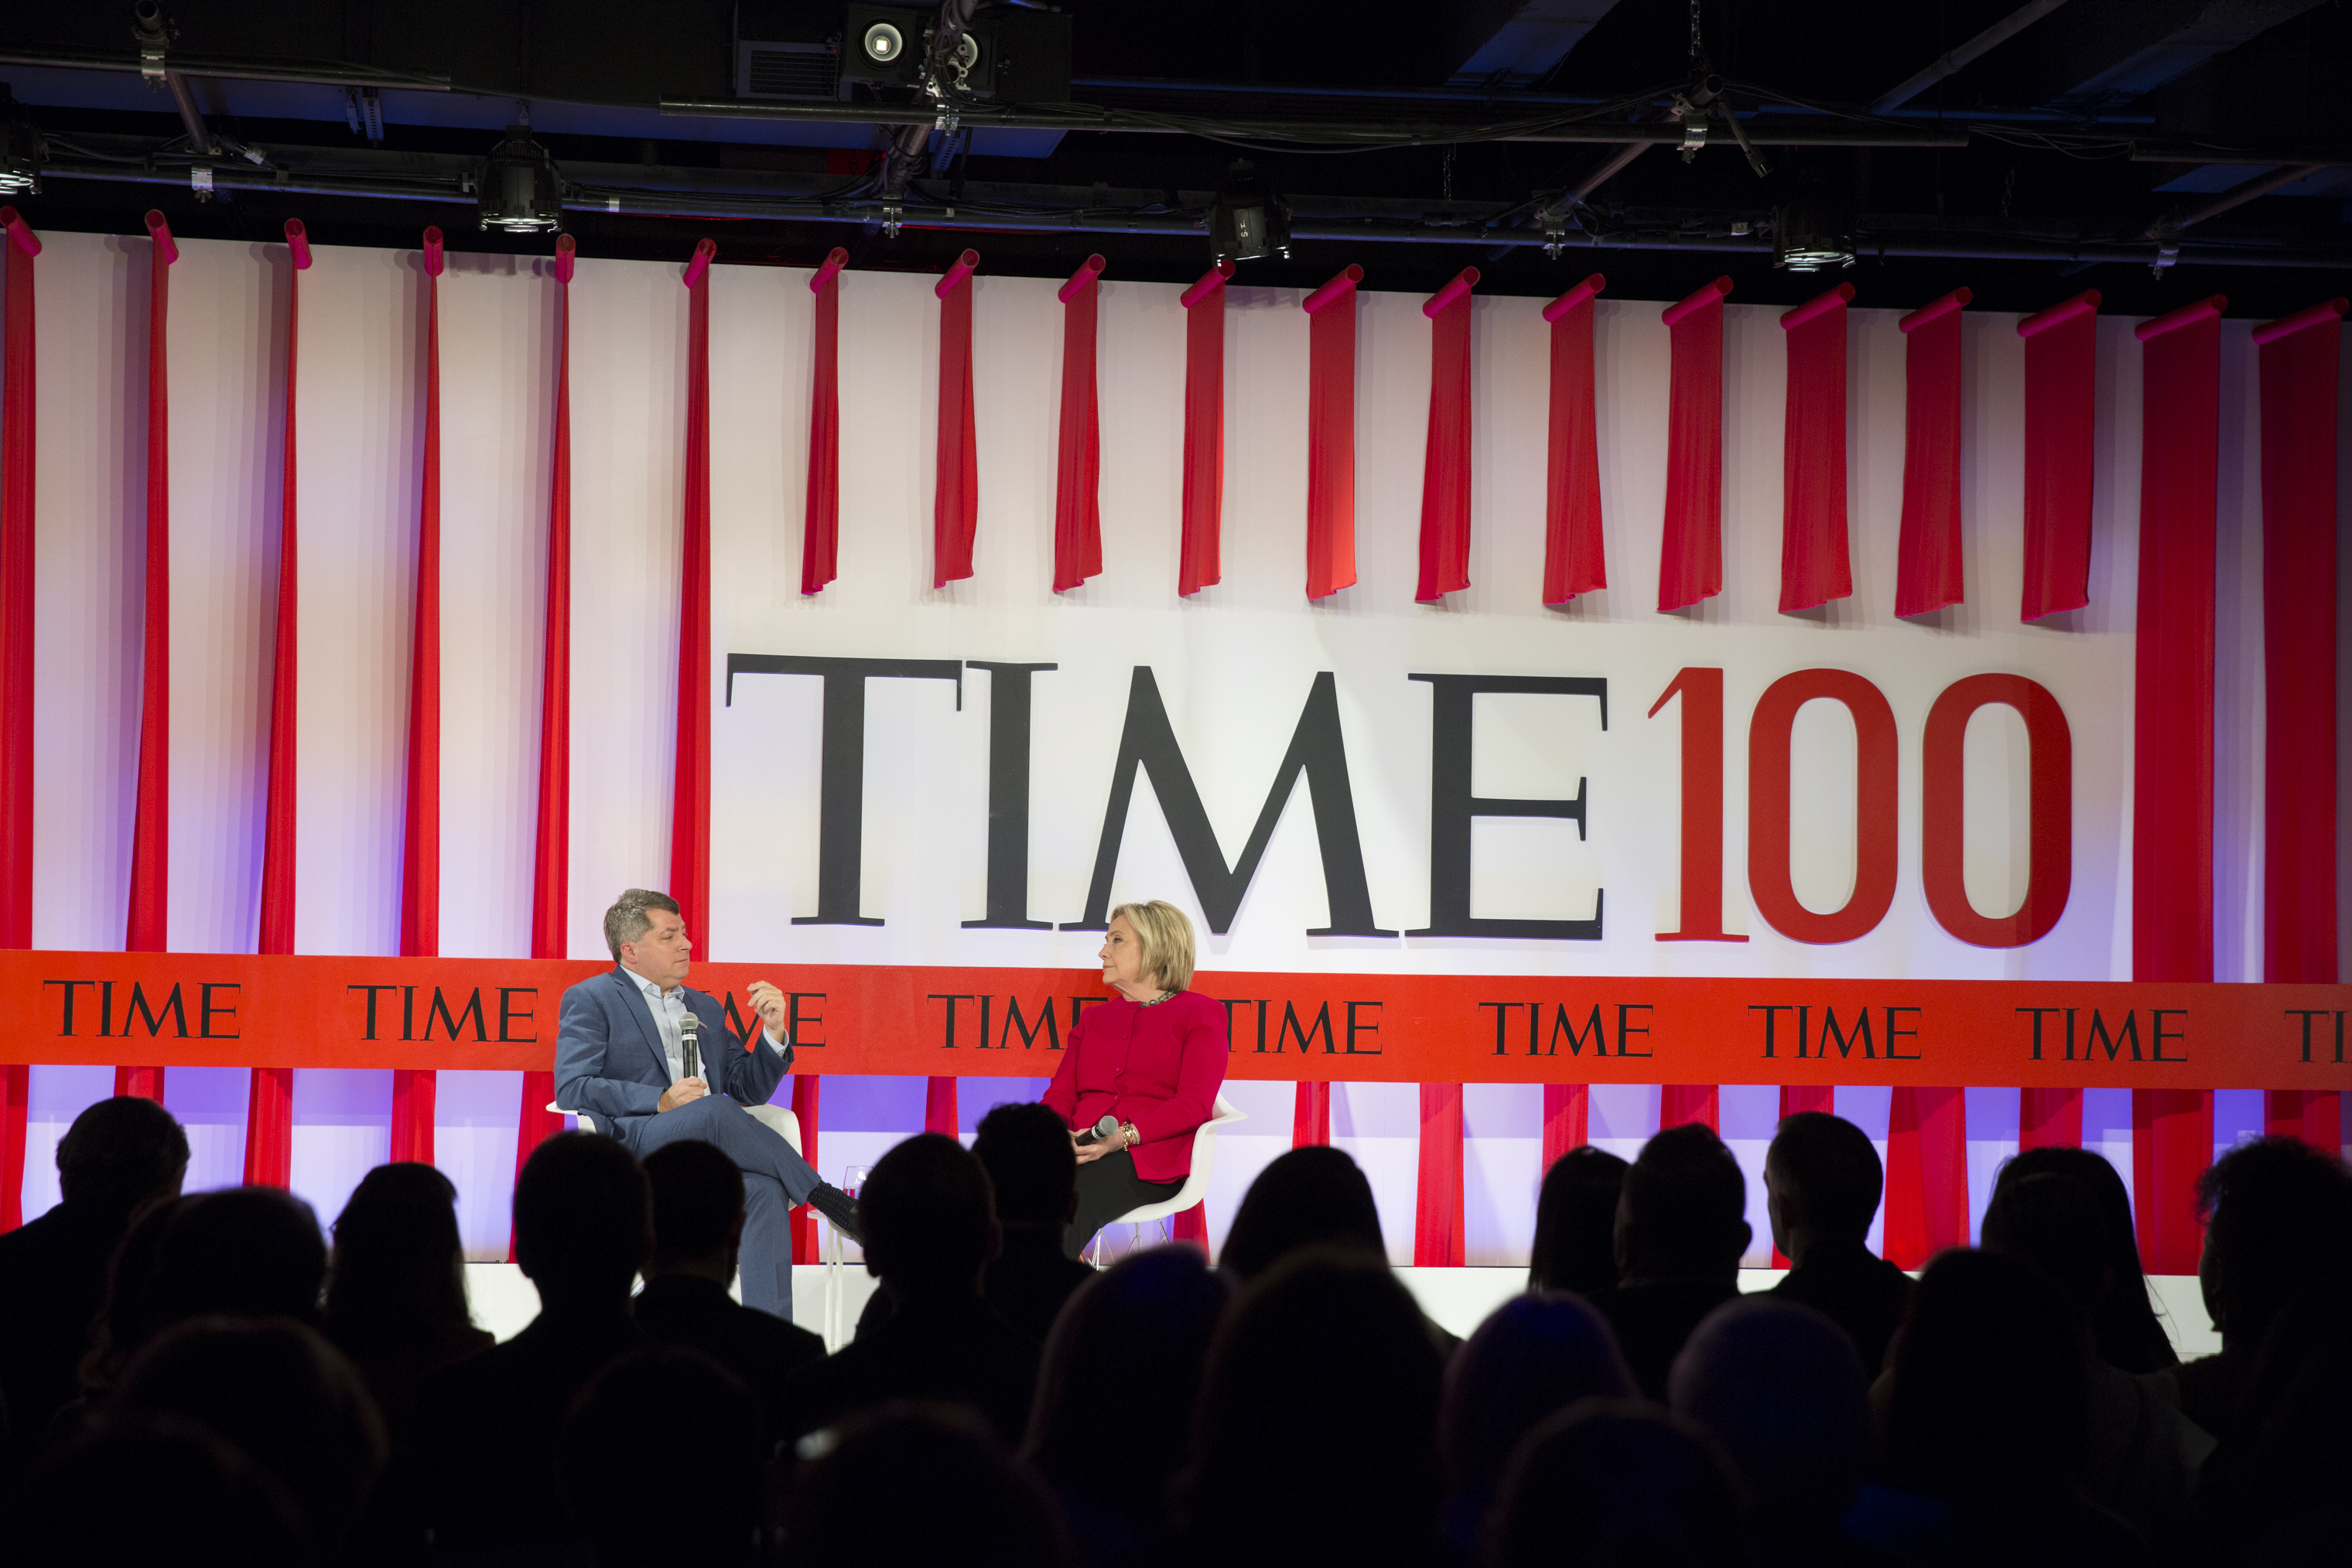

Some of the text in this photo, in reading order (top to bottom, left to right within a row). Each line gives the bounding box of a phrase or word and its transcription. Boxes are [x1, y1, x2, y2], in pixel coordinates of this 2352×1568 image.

[726, 653, 2073, 949] TIME 100
[43, 980, 241, 1039] TIME
[347, 986, 538, 1044] TIME
[1479, 1002, 1654, 1057] TIME
[1748, 1005, 1922, 1060] TIME
[2015, 1007, 2189, 1063] TIME
[2284, 1009, 2352, 1064] TI
